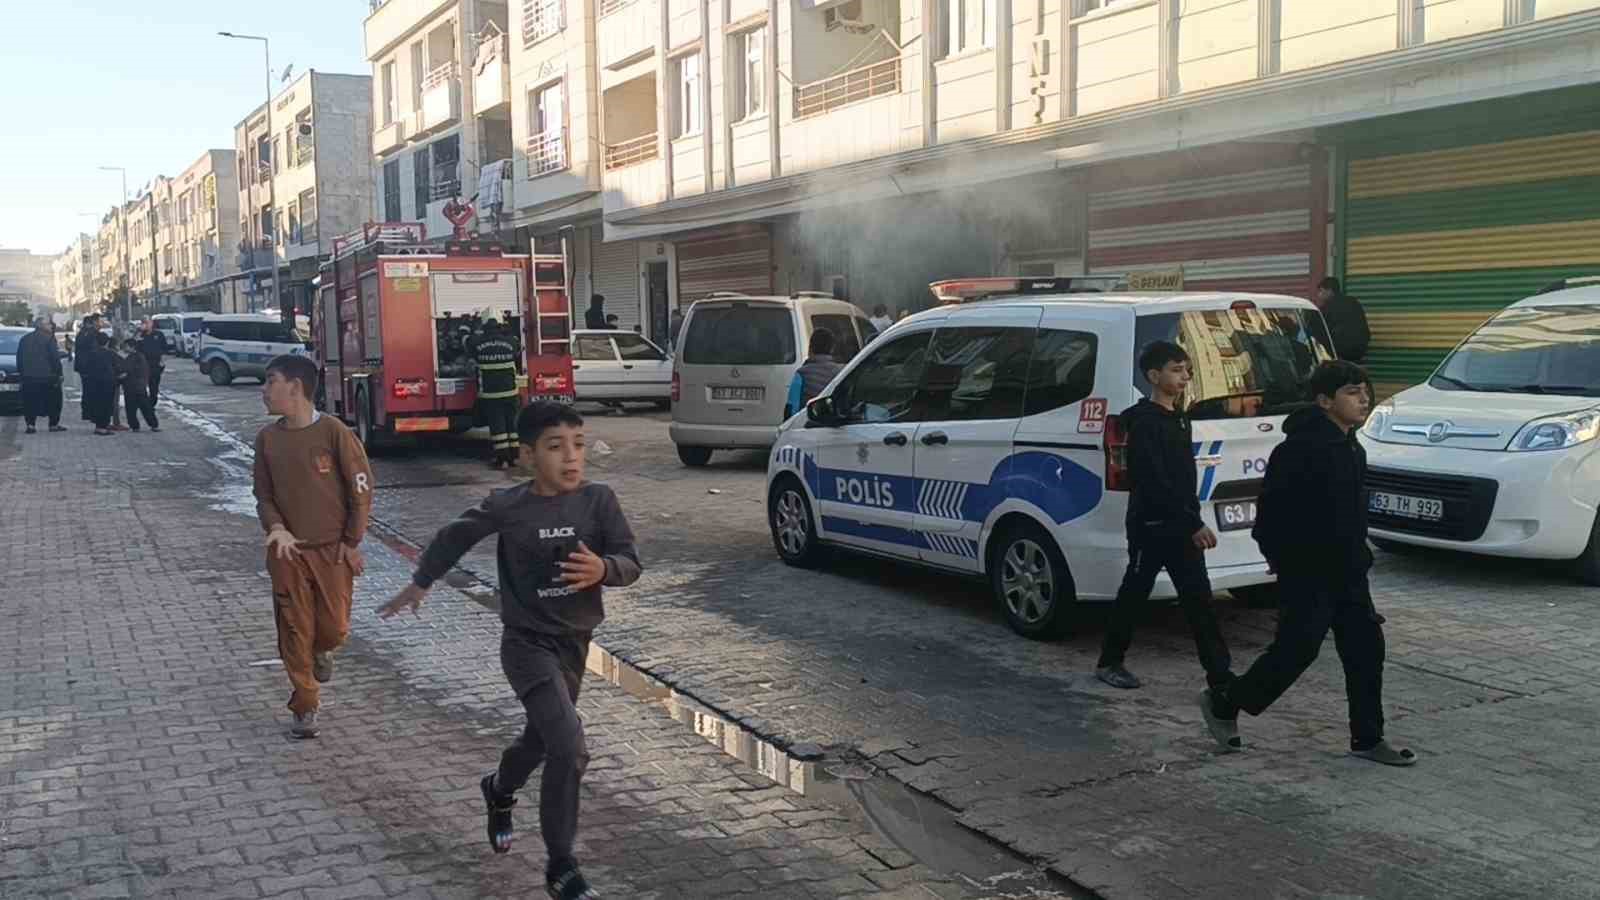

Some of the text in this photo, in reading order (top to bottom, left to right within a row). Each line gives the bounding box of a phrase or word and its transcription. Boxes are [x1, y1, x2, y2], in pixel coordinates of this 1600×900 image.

[1084, 401, 1102, 420] 112
[355, 472, 369, 494] R
[835, 475, 895, 508] POLİS
[1224, 504, 1245, 523] 63
[1374, 494, 1441, 516] 63 TH 992
[538, 526, 576, 539] BLACK
